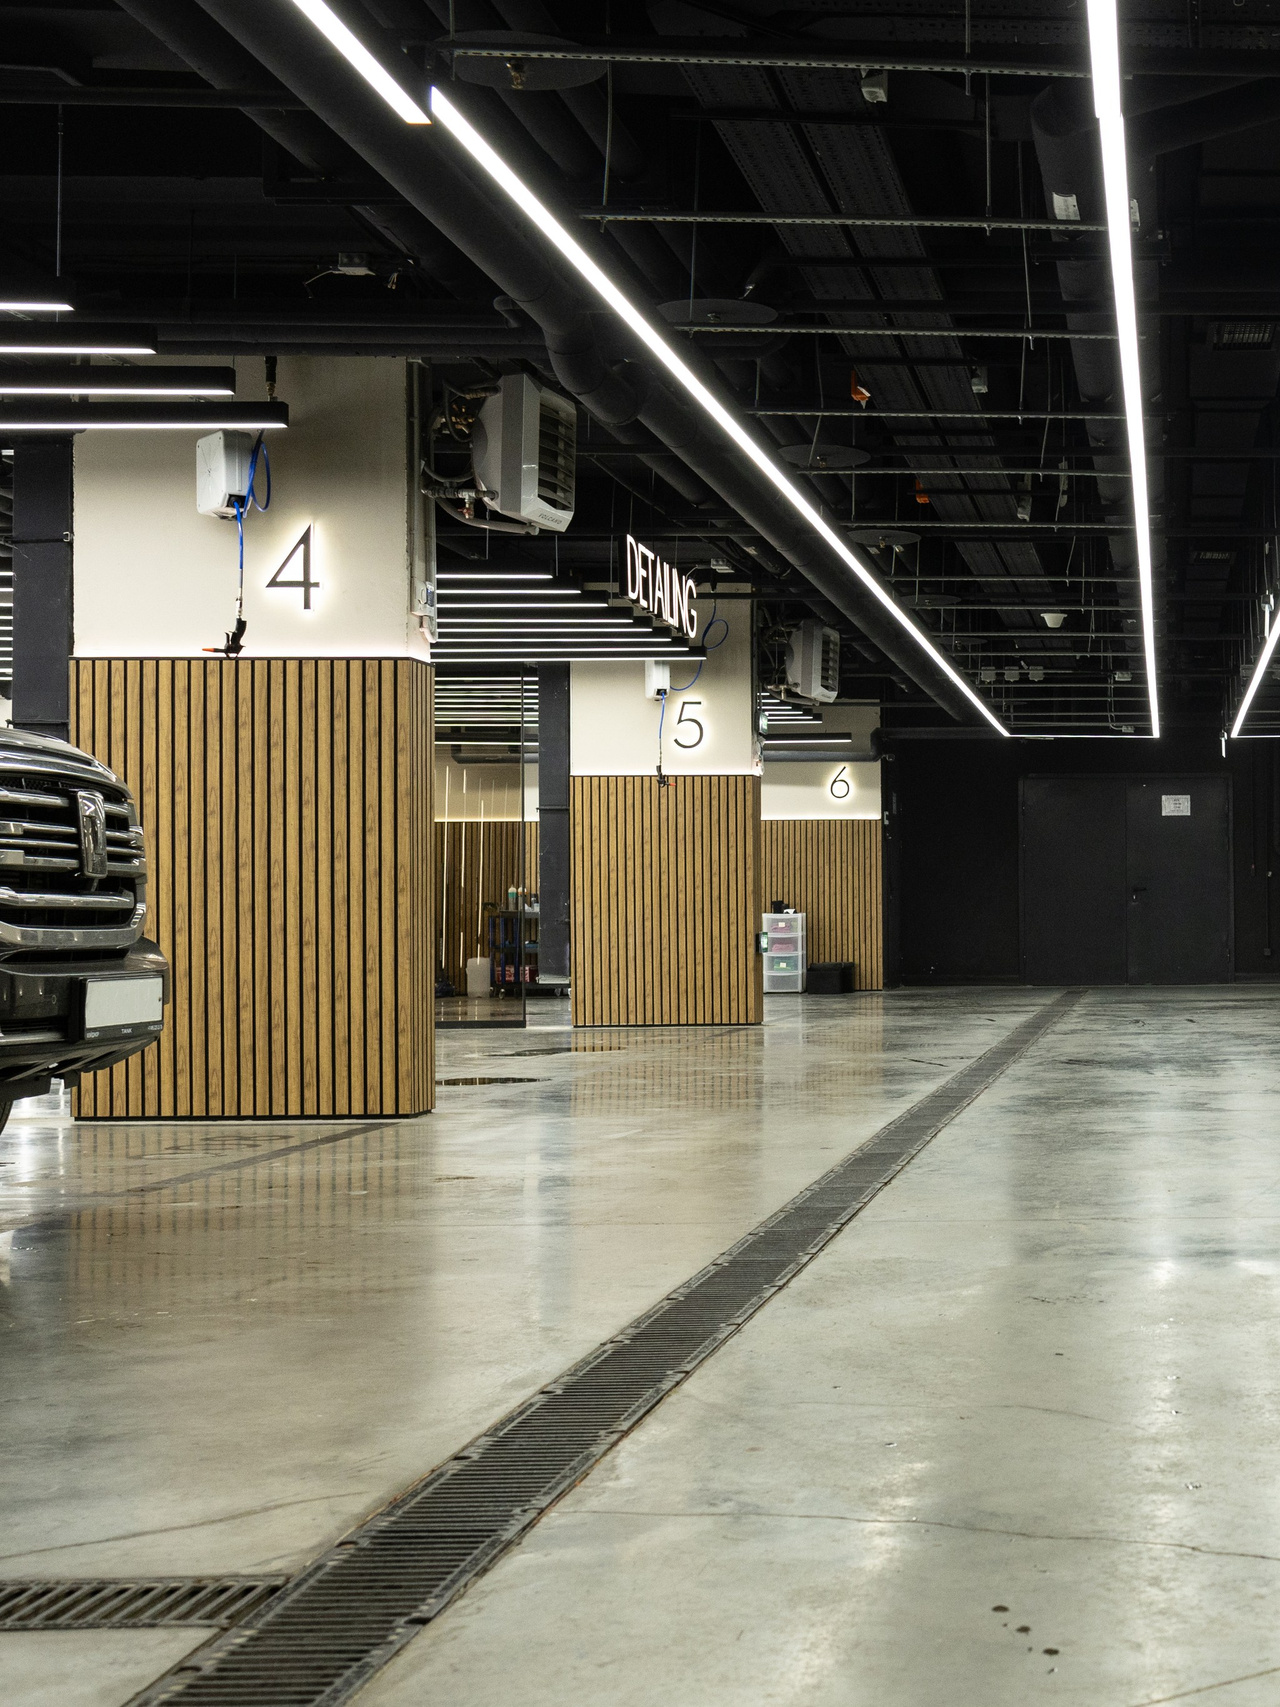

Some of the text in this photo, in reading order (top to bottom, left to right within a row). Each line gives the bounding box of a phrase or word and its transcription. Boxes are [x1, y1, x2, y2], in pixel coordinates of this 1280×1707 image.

[265, 523, 320, 610] 4
[626, 533, 697, 639] DETAILING
[673, 701, 704, 749] 5
[830, 766, 850, 799] 6
